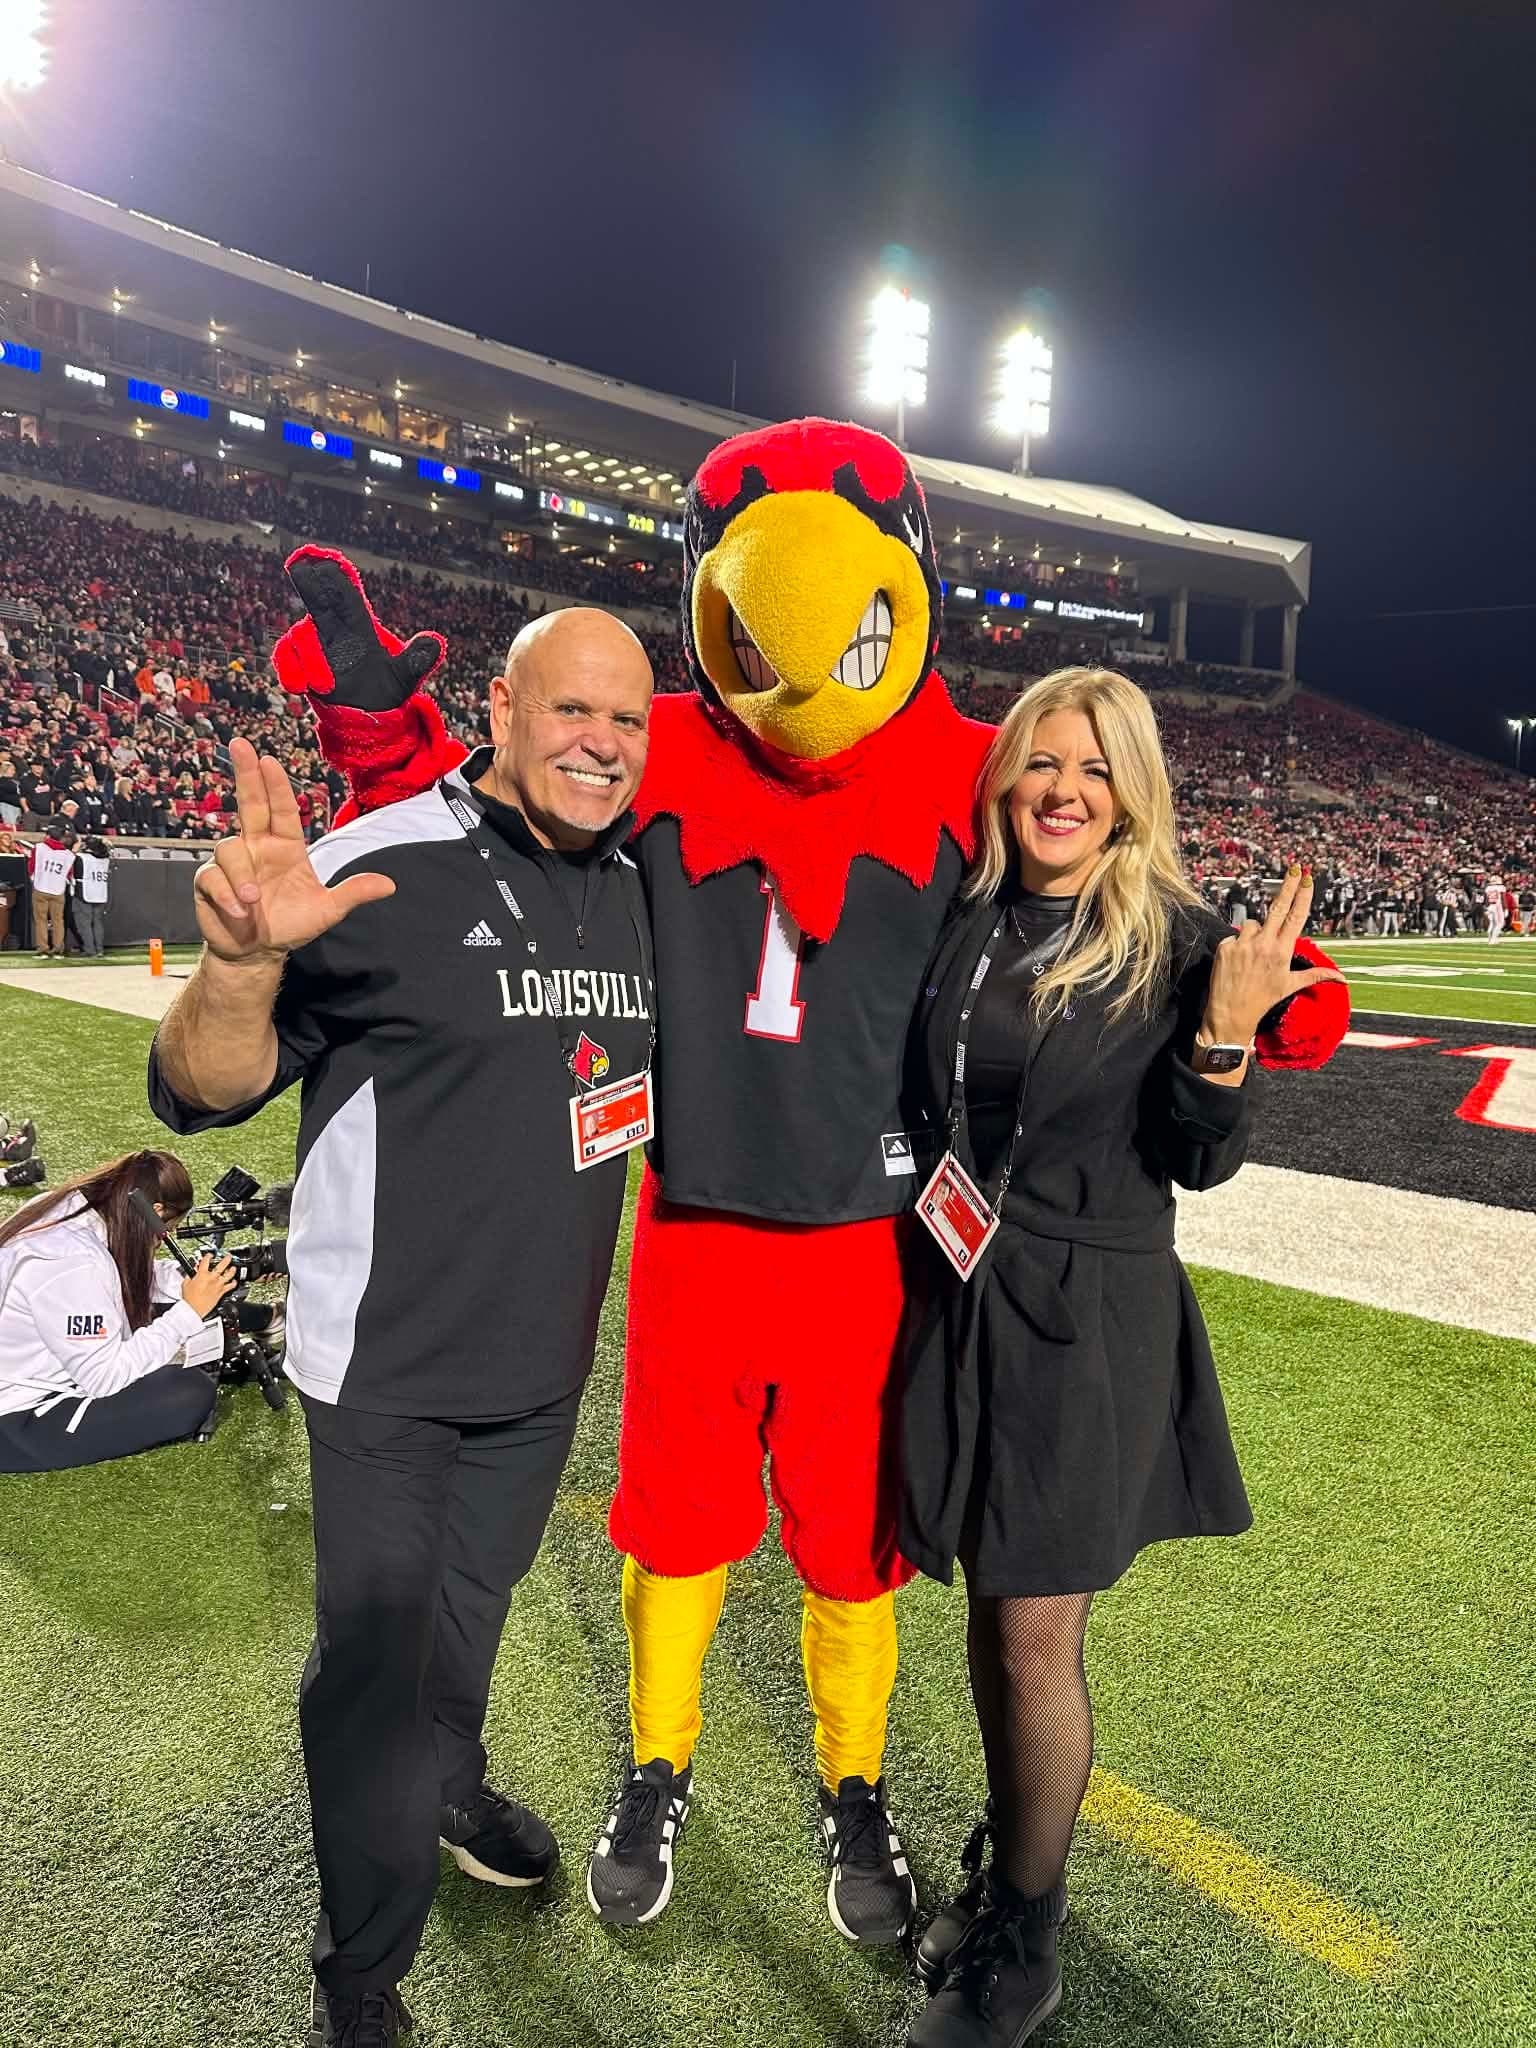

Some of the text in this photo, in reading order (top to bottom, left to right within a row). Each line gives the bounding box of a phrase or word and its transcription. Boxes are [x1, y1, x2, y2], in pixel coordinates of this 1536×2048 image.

[463, 936, 502, 946] adidas
[743, 878, 807, 1043] 1
[496, 969, 653, 1020] LOUISVILL
